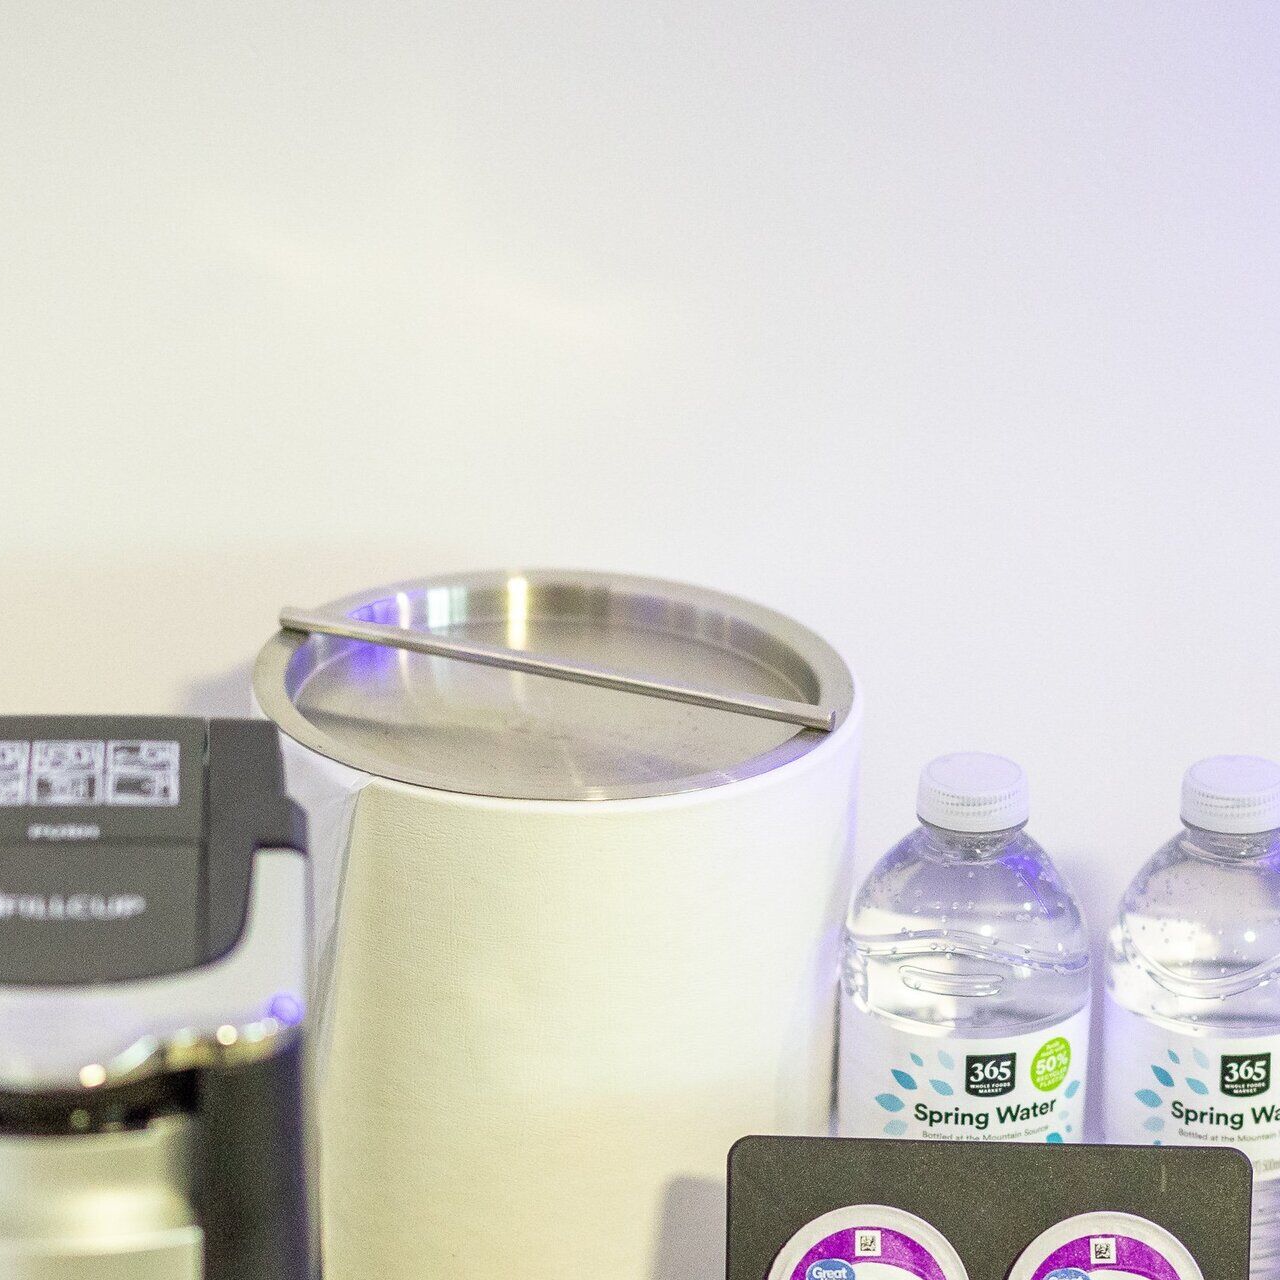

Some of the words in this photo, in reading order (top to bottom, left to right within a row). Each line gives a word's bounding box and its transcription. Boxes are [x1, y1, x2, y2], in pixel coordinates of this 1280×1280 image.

[970, 1060, 1012, 1083] 365
[1036, 1052, 1069, 1076] 50%
[1224, 1059, 1267, 1083] 365
[914, 1103, 990, 1130] Spring
[996, 1099, 1057, 1124] Water
[1171, 1100, 1244, 1130] Spring
[922, 1130, 953, 1140] Bottled
[965, 1132, 980, 1141] the
[982, 1130, 1022, 1141] Mountain
[1023, 1124, 1049, 1136] Source
[1178, 1128, 1208, 1140] Bottled
[1221, 1134, 1235, 1142] the
[1237, 1131, 1277, 1142] Mountain
[812, 1266, 848, 1280] Great
